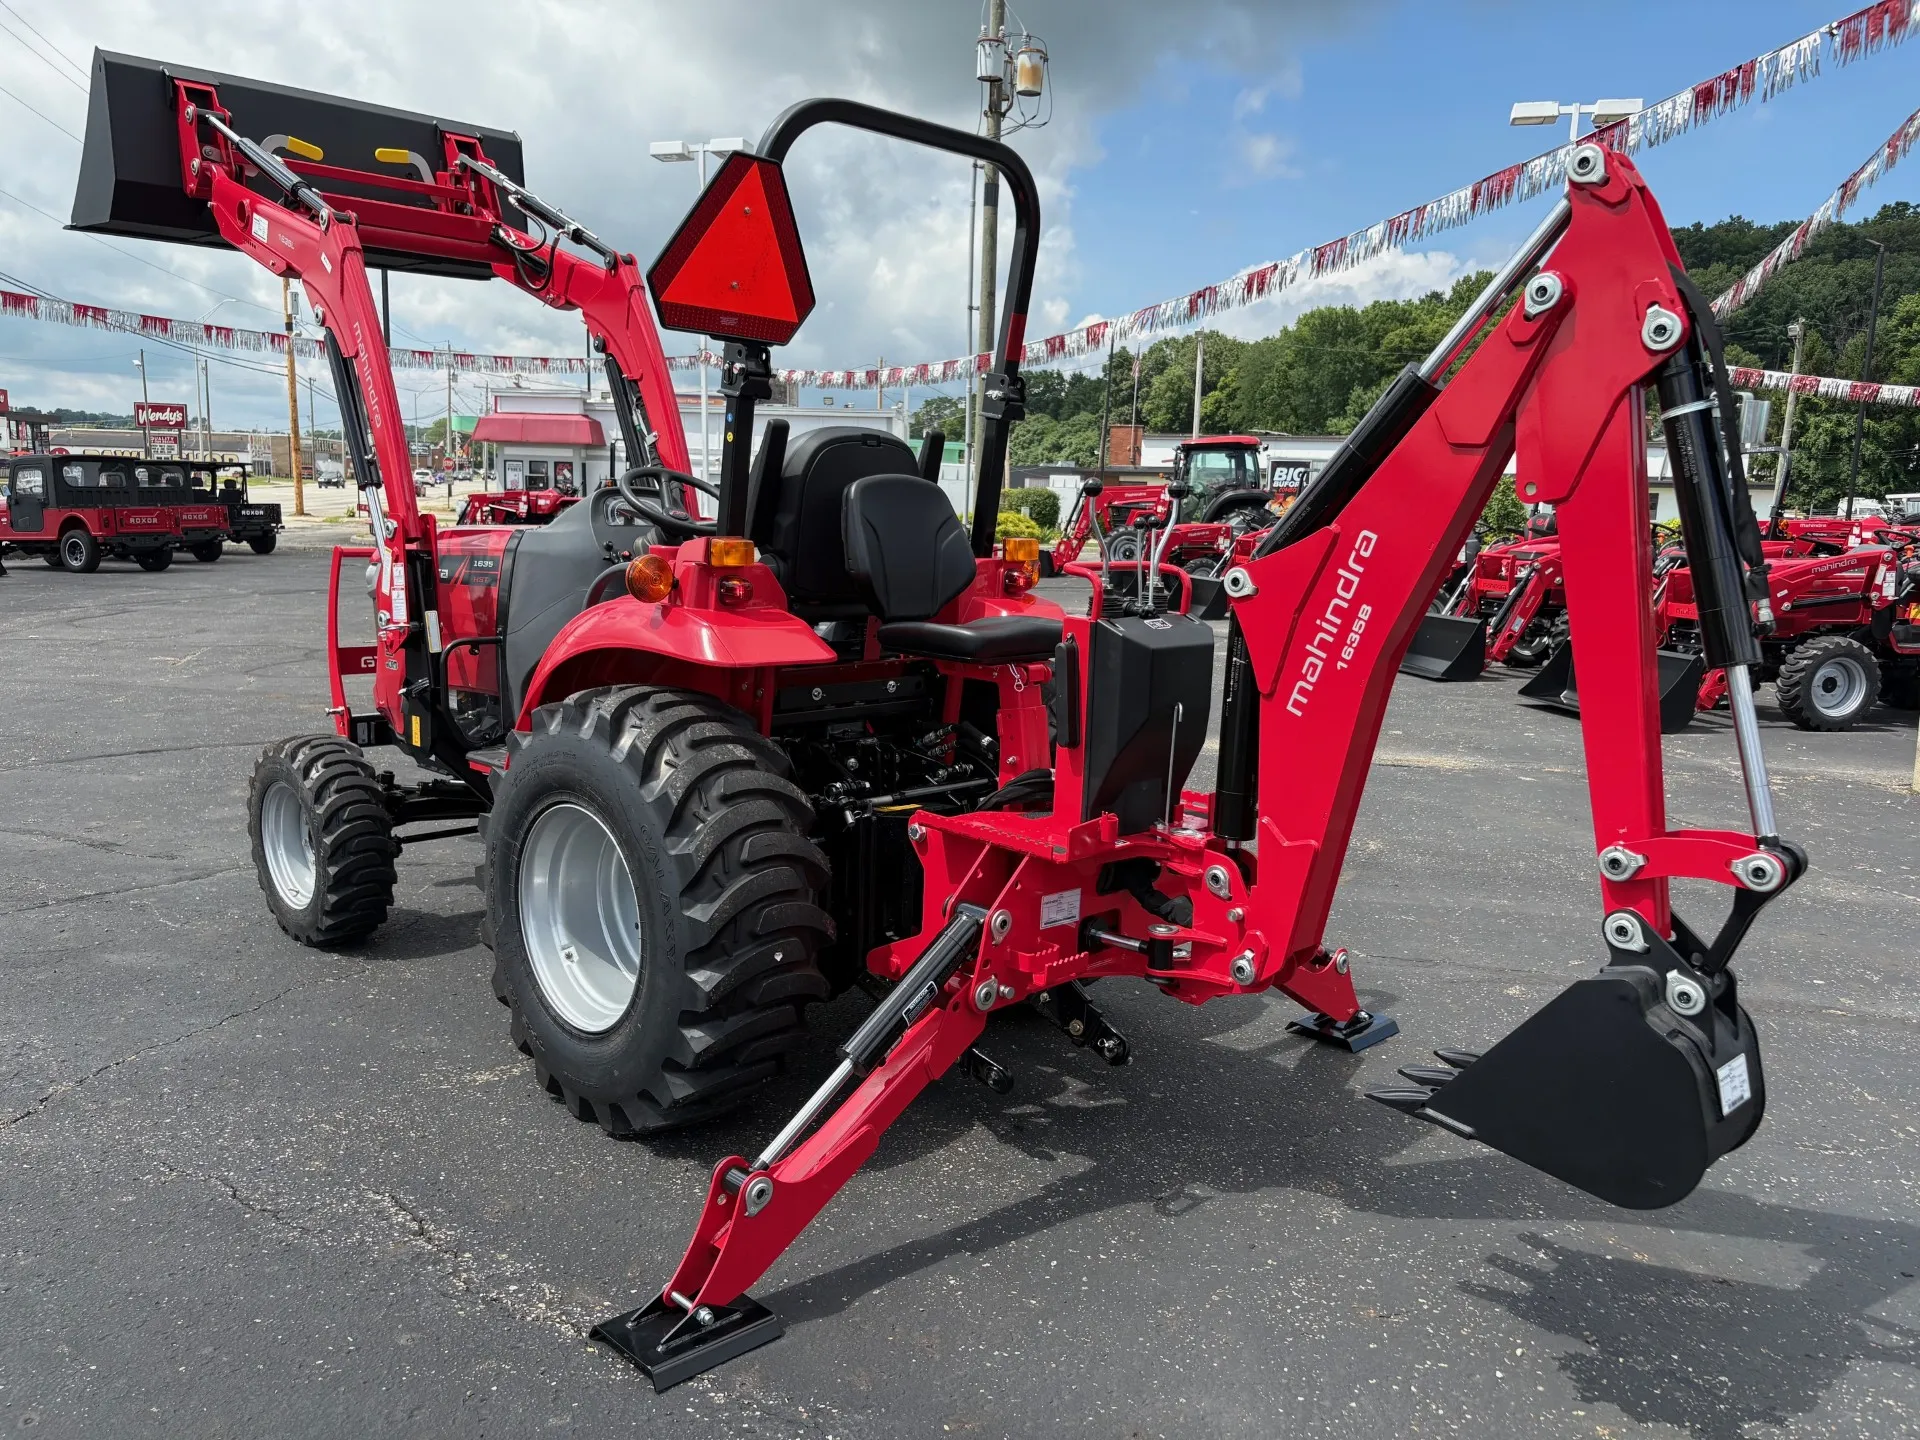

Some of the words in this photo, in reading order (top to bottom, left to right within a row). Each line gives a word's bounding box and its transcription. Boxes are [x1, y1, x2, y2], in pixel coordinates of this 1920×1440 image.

[353, 321, 382, 428] mahindra
[138, 408, 183, 425] Wendy's
[473, 560, 494, 568] 1635
[1811, 556, 1858, 575] mahindra
[1286, 529, 1379, 717] mahindra
[1336, 603, 1373, 671] 1635B
